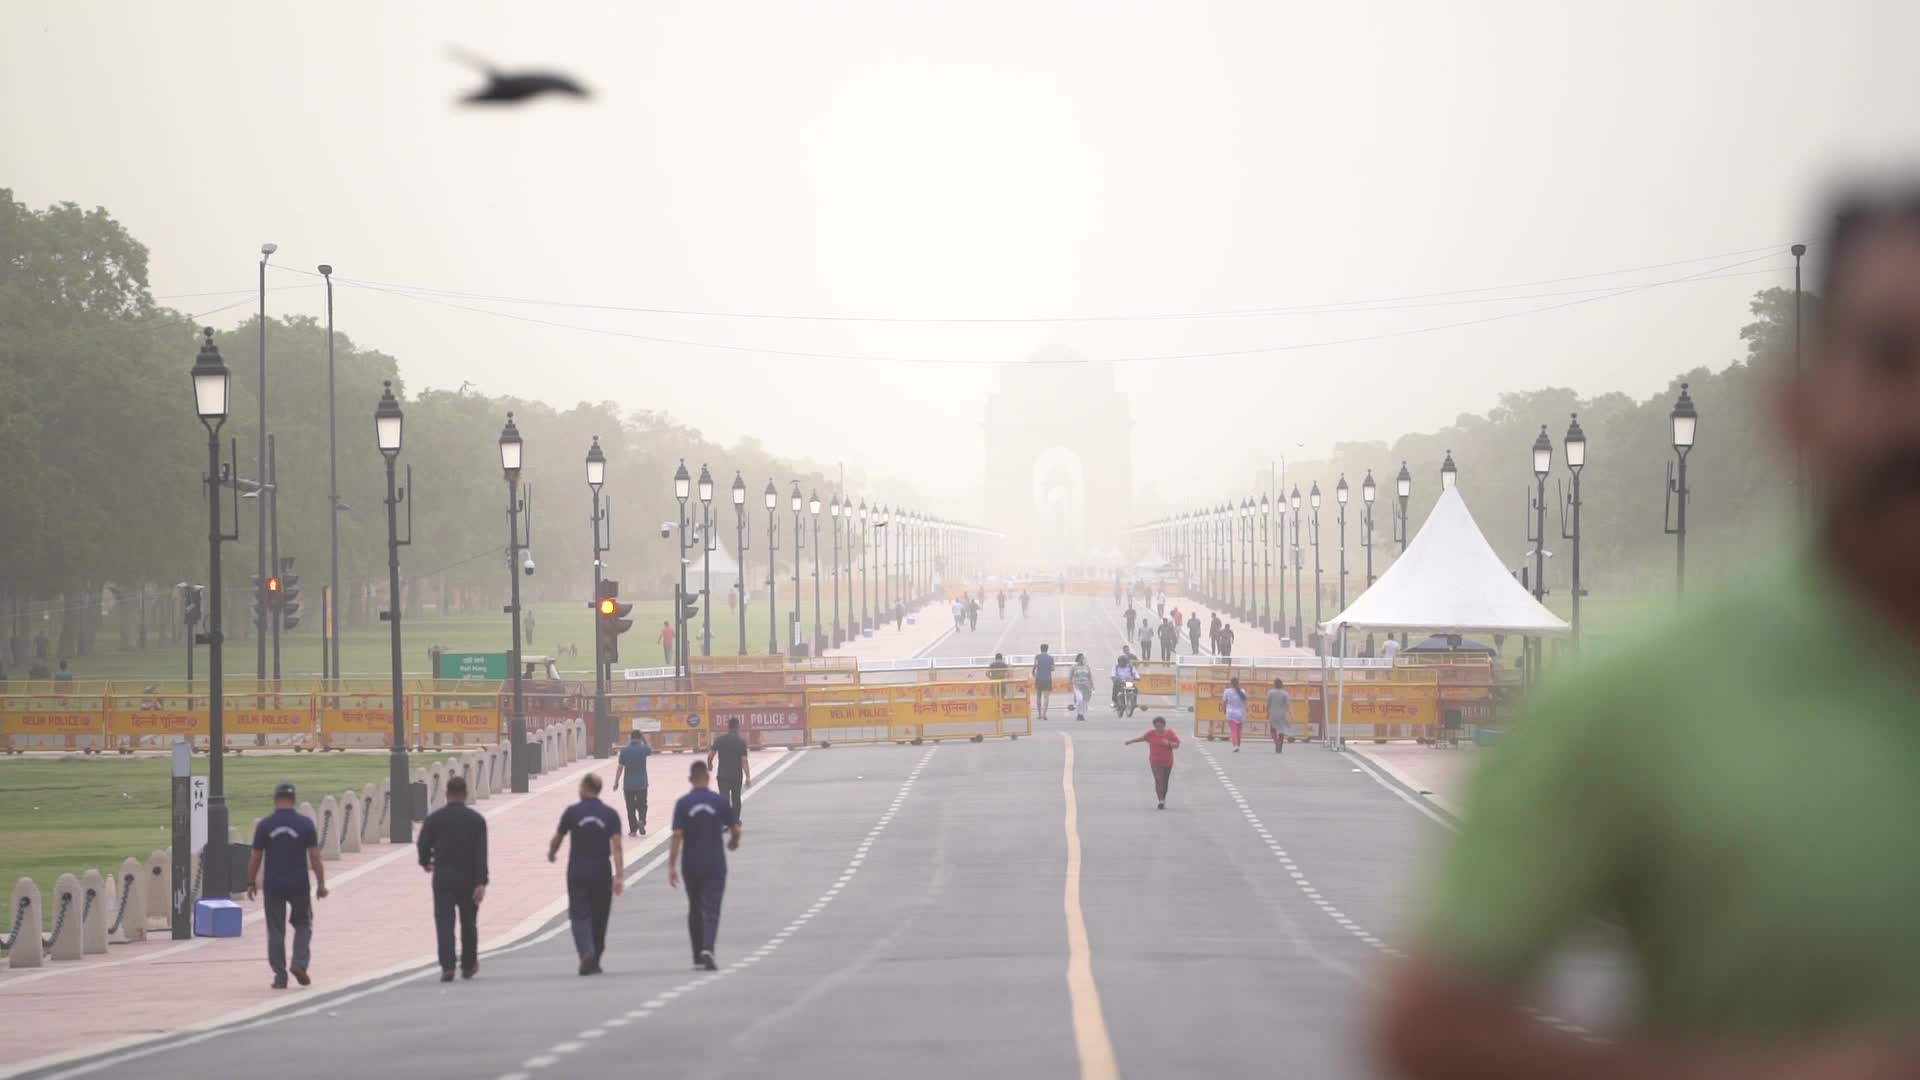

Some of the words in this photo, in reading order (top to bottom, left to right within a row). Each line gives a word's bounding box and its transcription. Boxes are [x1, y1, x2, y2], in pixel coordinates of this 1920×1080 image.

[435, 713, 455, 724] DELHI
[750, 712, 785, 725] POLICE
[830, 708, 855, 719] DELHI
[858, 707, 888, 718] POLICE
[22, 715, 46, 726] DELHI
[48, 715, 81, 726] POLICE
[237, 714, 261, 725] DELHI
[262, 714, 289, 725] POLICE
